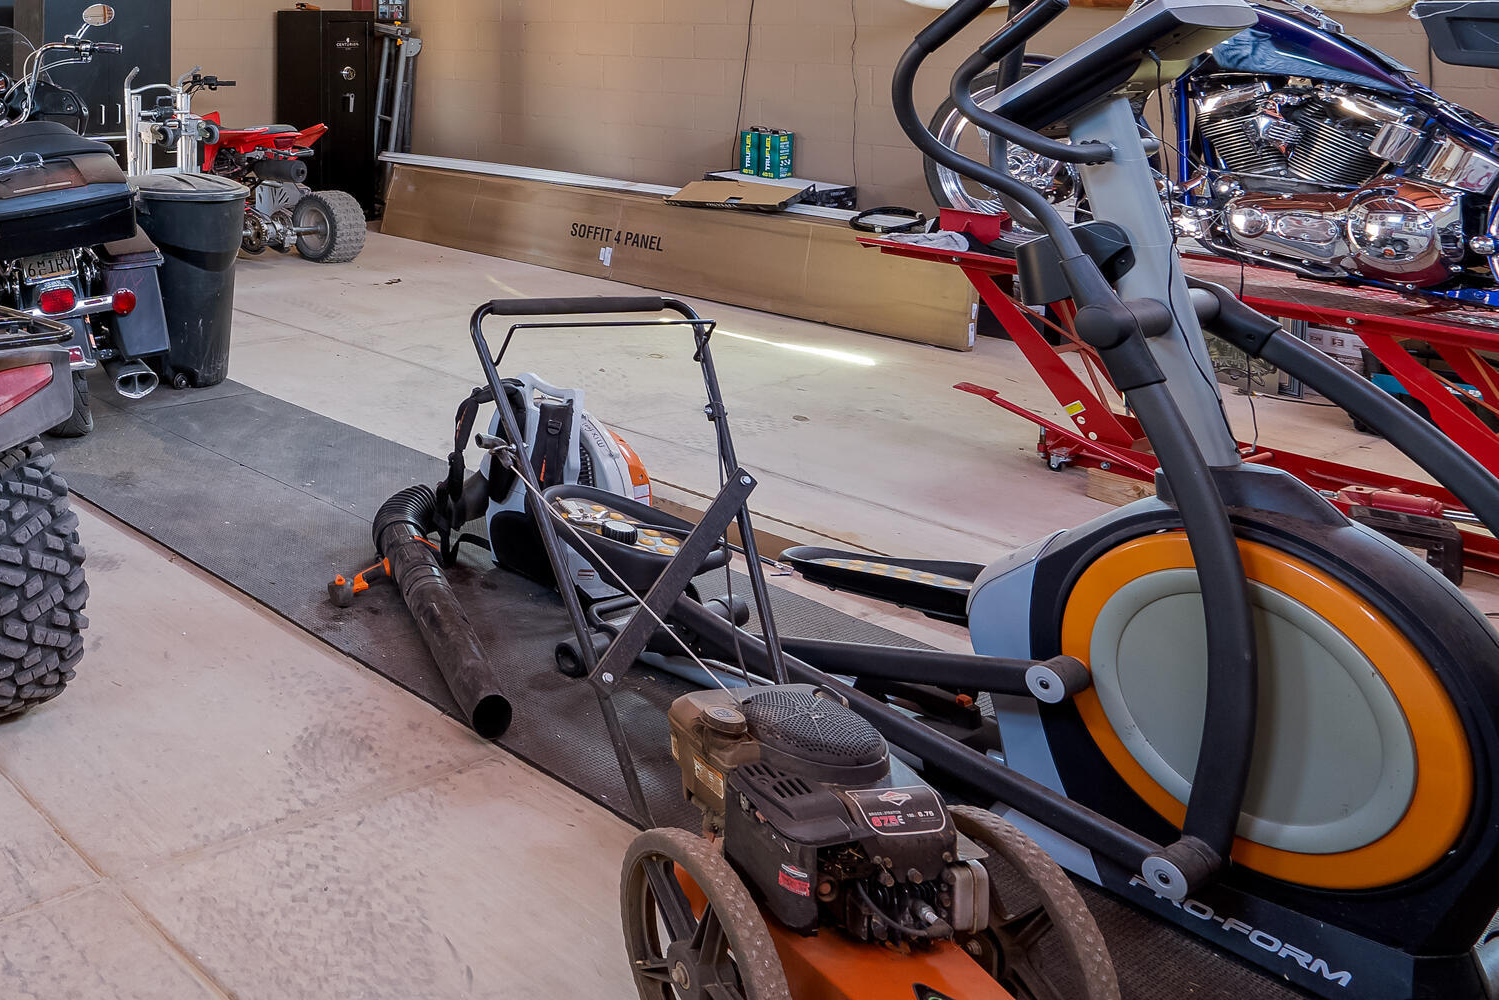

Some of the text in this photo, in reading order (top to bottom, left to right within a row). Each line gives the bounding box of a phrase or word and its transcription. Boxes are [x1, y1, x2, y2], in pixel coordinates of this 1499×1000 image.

[570, 222, 663, 252] SOFFIT 4 PANEL
